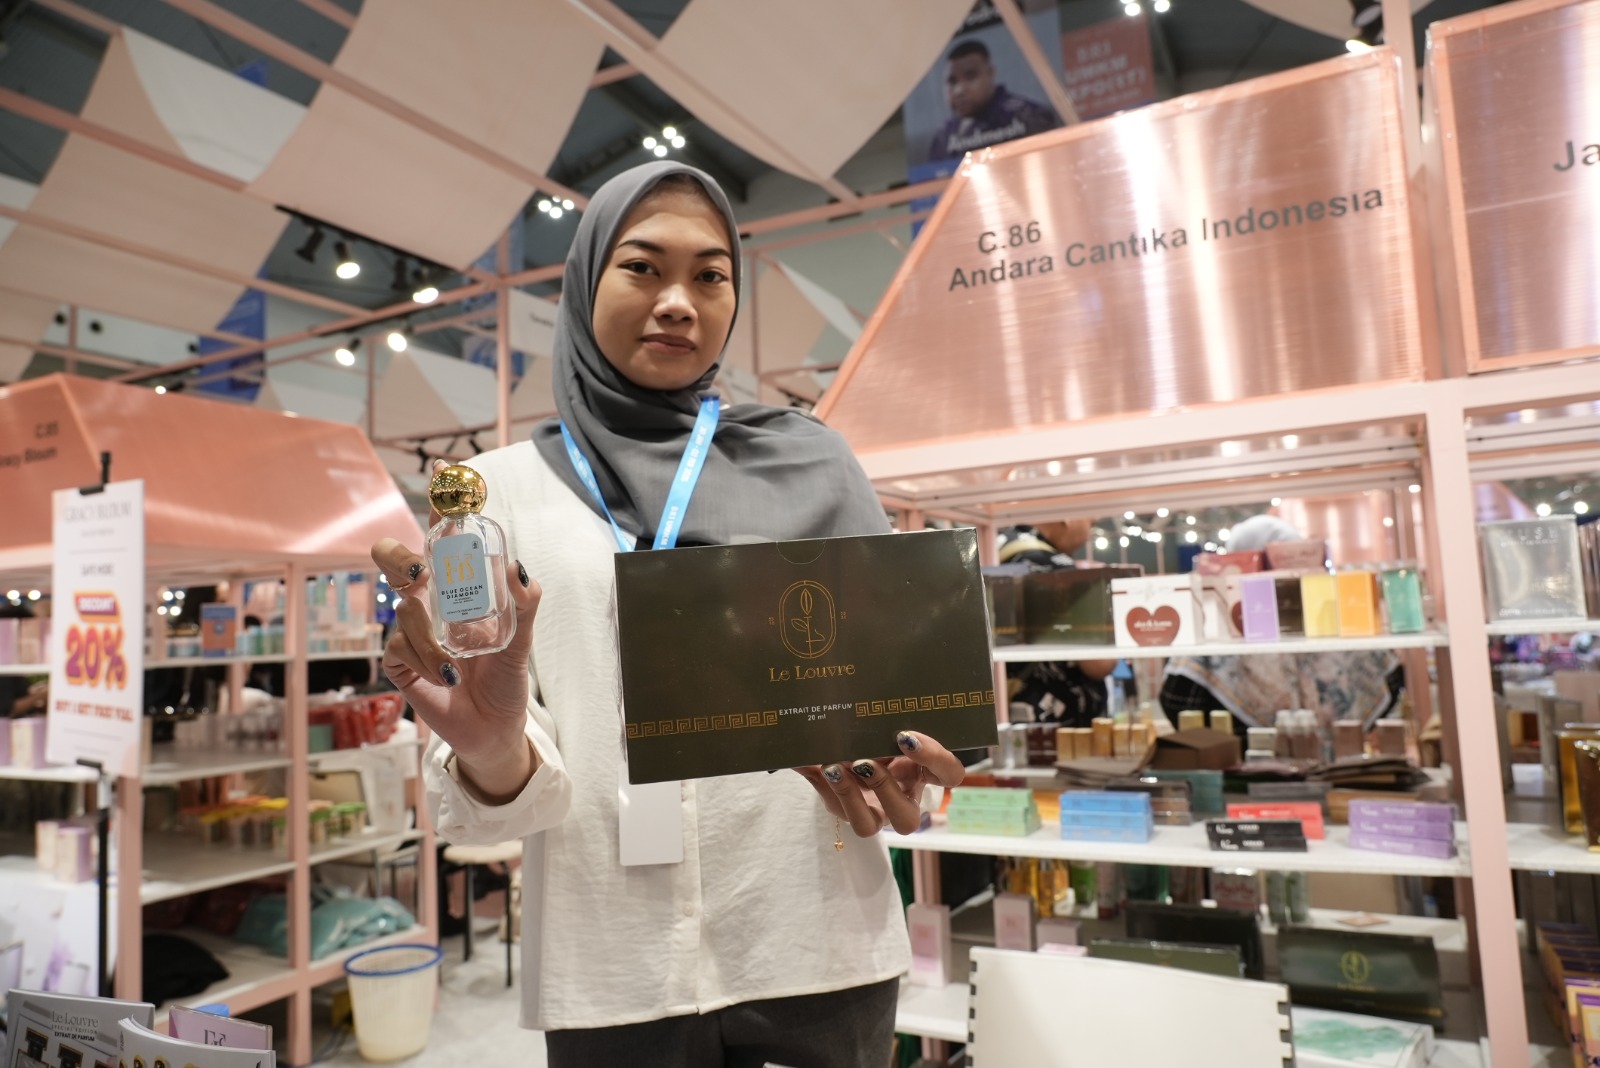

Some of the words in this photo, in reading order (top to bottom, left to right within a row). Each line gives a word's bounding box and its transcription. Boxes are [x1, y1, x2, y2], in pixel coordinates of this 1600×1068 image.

[949, 255, 1053, 291] Andara
[1065, 228, 1188, 268] Cantika
[1202, 189, 1382, 241] Indonesia
[978, 221, 1041, 255] C.86
[441, 588, 458, 596] BLUE
[459, 584, 483, 594] OCEAN
[446, 590, 479, 600] DIAMOND
[65, 625, 127, 690] 20%
[768, 667, 791, 682] Le
[794, 664, 856, 680] Louvre
[779, 705, 809, 715] EXTRAIT
[811, 704, 822, 713] DE
[823, 702, 853, 712] PARFUM
[51, 1011, 64, 1023] Le
[65, 1011, 99, 1028] Louvre
[54, 1031, 71, 1040] EXTRAIT
[77, 1034, 96, 1042] PARFUM
